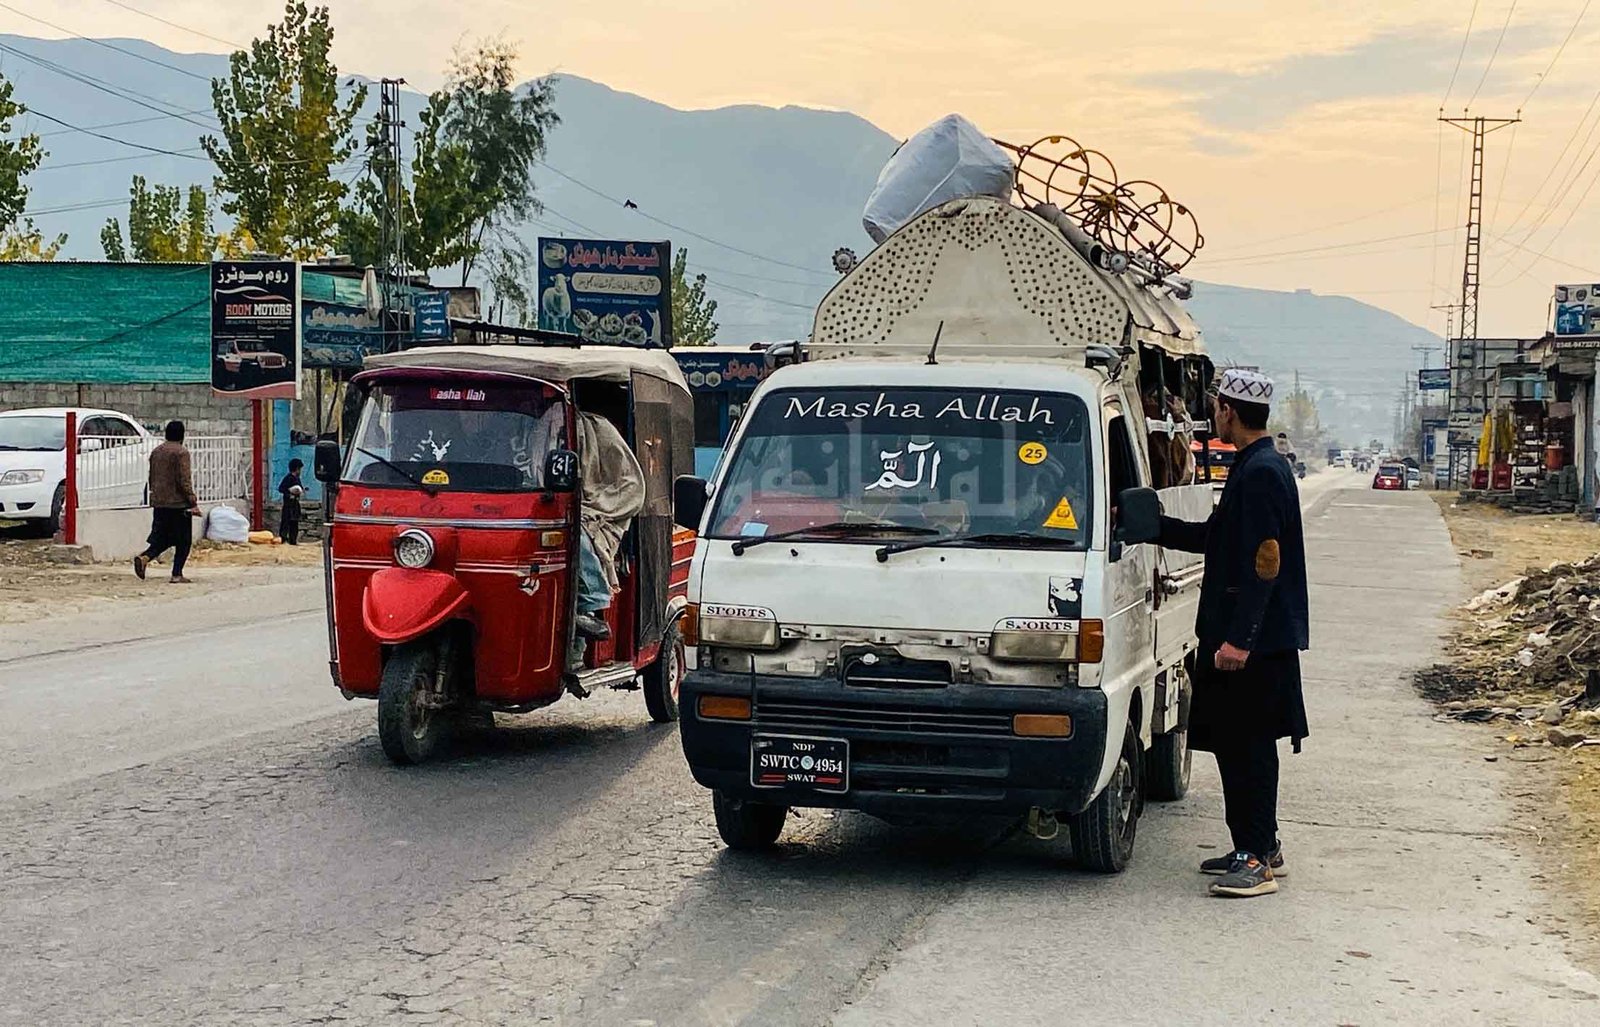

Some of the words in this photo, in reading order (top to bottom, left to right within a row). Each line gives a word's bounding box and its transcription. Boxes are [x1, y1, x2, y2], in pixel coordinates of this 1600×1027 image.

[217, 265, 264, 284] موٹرز
[265, 269, 289, 284] روم
[225, 303, 252, 316] ROOM
[253, 303, 292, 316] MOTORS
[783, 392, 925, 420] Masha
[935, 393, 1055, 424] Allah
[1024, 447, 1043, 459] 25
[792, 742, 815, 752] NDP
[760, 753, 800, 770] SWTC
[814, 758, 843, 774] 4954
[787, 773, 816, 783] SWAT
